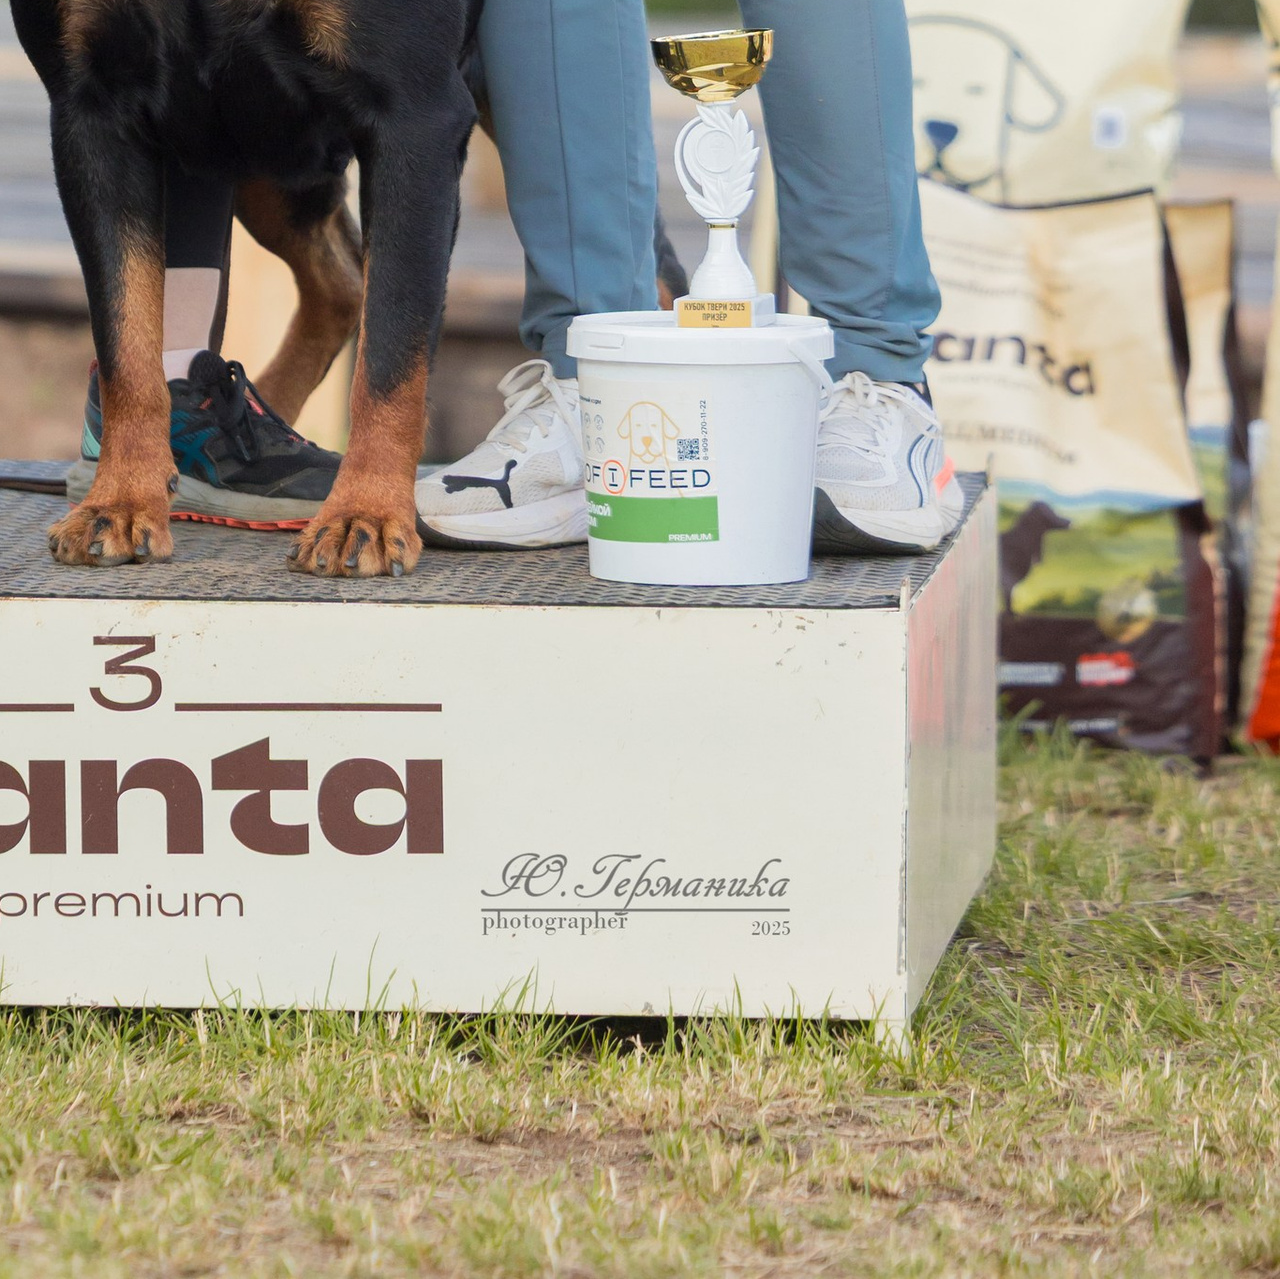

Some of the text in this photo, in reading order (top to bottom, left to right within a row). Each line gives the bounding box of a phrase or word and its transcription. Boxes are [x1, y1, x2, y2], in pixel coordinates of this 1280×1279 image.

[684, 302, 745, 311] КУБОК ТВЕРИ 2025
[934, 331, 1095, 396] anta
[700, 399, 709, 461] 8-909-270-11-22
[668, 532, 713, 542] PREMIUM
[89, 635, 163, 712] 3
